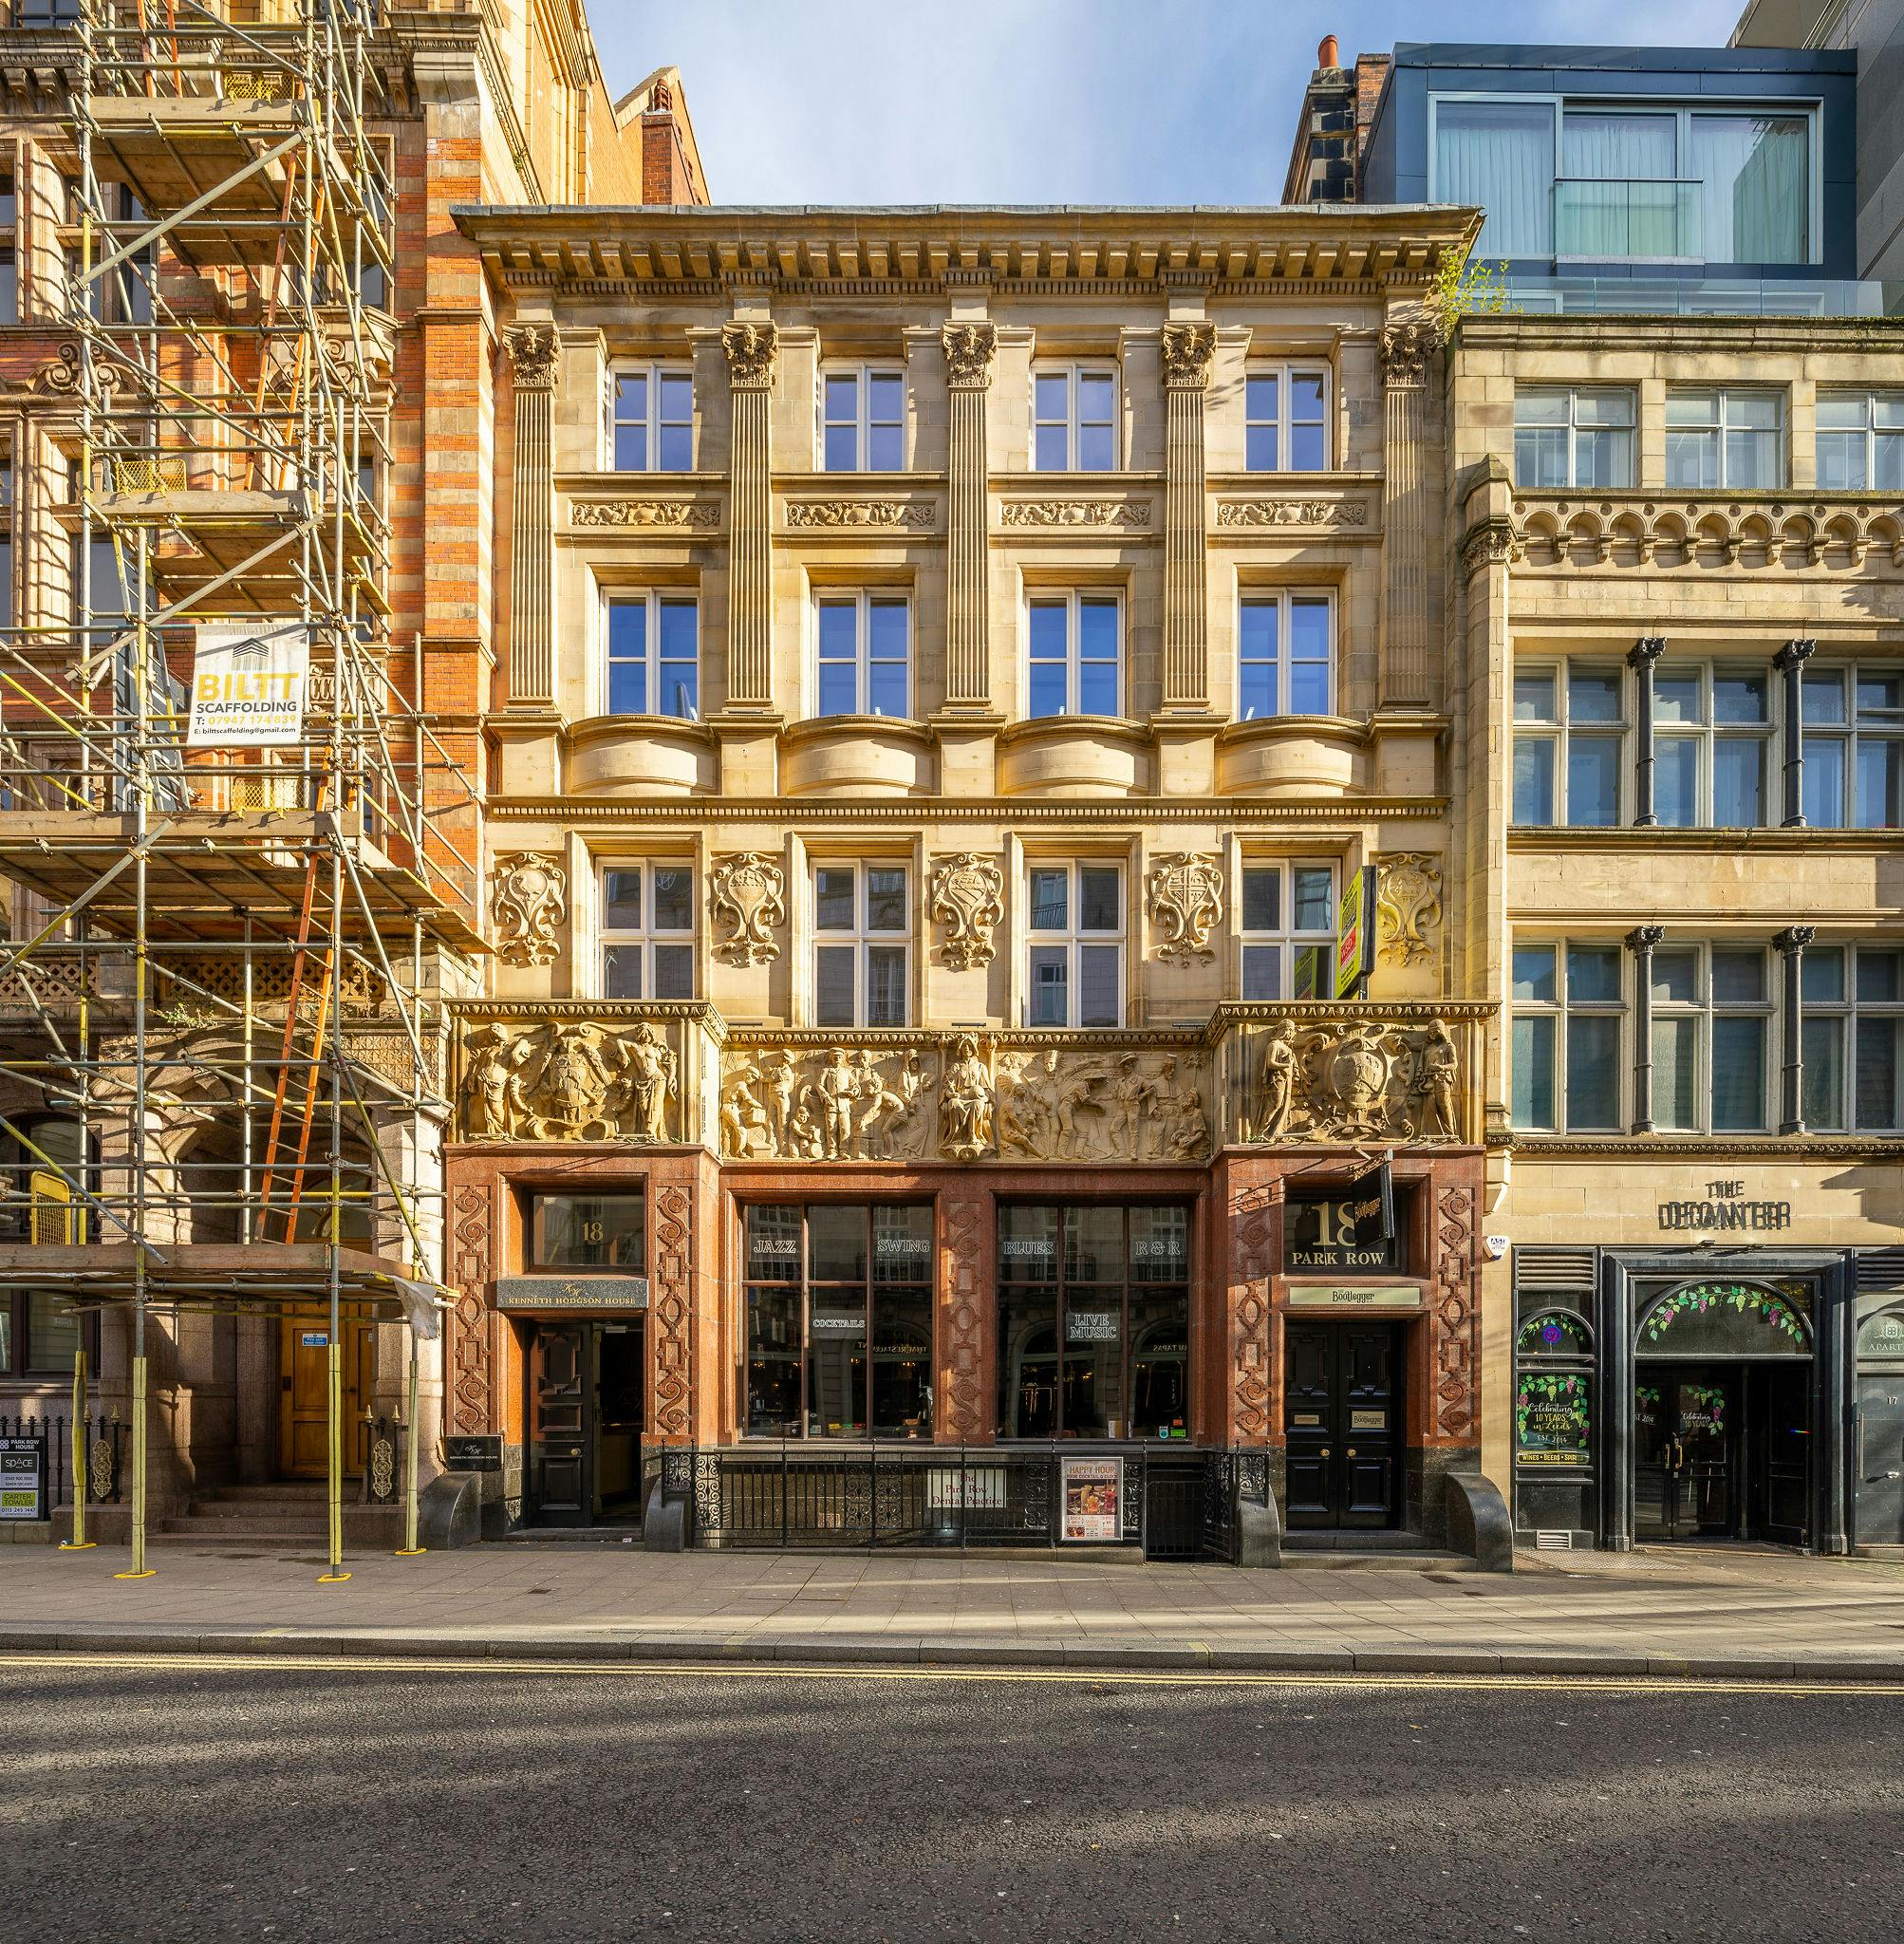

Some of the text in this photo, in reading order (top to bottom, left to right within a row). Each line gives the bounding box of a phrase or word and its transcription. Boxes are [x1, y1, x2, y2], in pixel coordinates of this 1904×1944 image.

[196, 672, 299, 701] BILTT
[196, 701, 297, 714] SCAFFOLDING
[196, 717, 205, 725] T:
[209, 716, 245, 725] 07947
[250, 716, 271, 724] 174
[202, 727, 296, 736] bilttscaffolding@gmail.com
[1705, 1180, 1745, 1199] THE
[1658, 1201, 1791, 1231] DECANTER
[1312, 1201, 1356, 1246] 18
[581, 1222, 604, 1241] 18
[754, 1240, 796, 1254] JAZZ
[877, 1239, 930, 1253] SWING
[1003, 1241, 1055, 1255] BLUES
[1135, 1241, 1181, 1255] R & R
[1292, 1252, 1386, 1265] PARK ROW
[1332, 1290, 1374, 1303] Bootlegger
[812, 1318, 866, 1328] COCKTAILS
[1074, 1314, 1110, 1326] LIVE
[1070, 1326, 1117, 1338] MUSIC
[1888, 1396, 1898, 1405] 17
[1528, 1402, 1573, 1417] Celebrating
[1536, 1413, 1566, 1422] 10 YEARS
[1545, 1421, 1573, 1431] Leeds
[1069, 1466, 1115, 1474] HAPPY HOUR
[968, 1484, 989, 1493] Row
